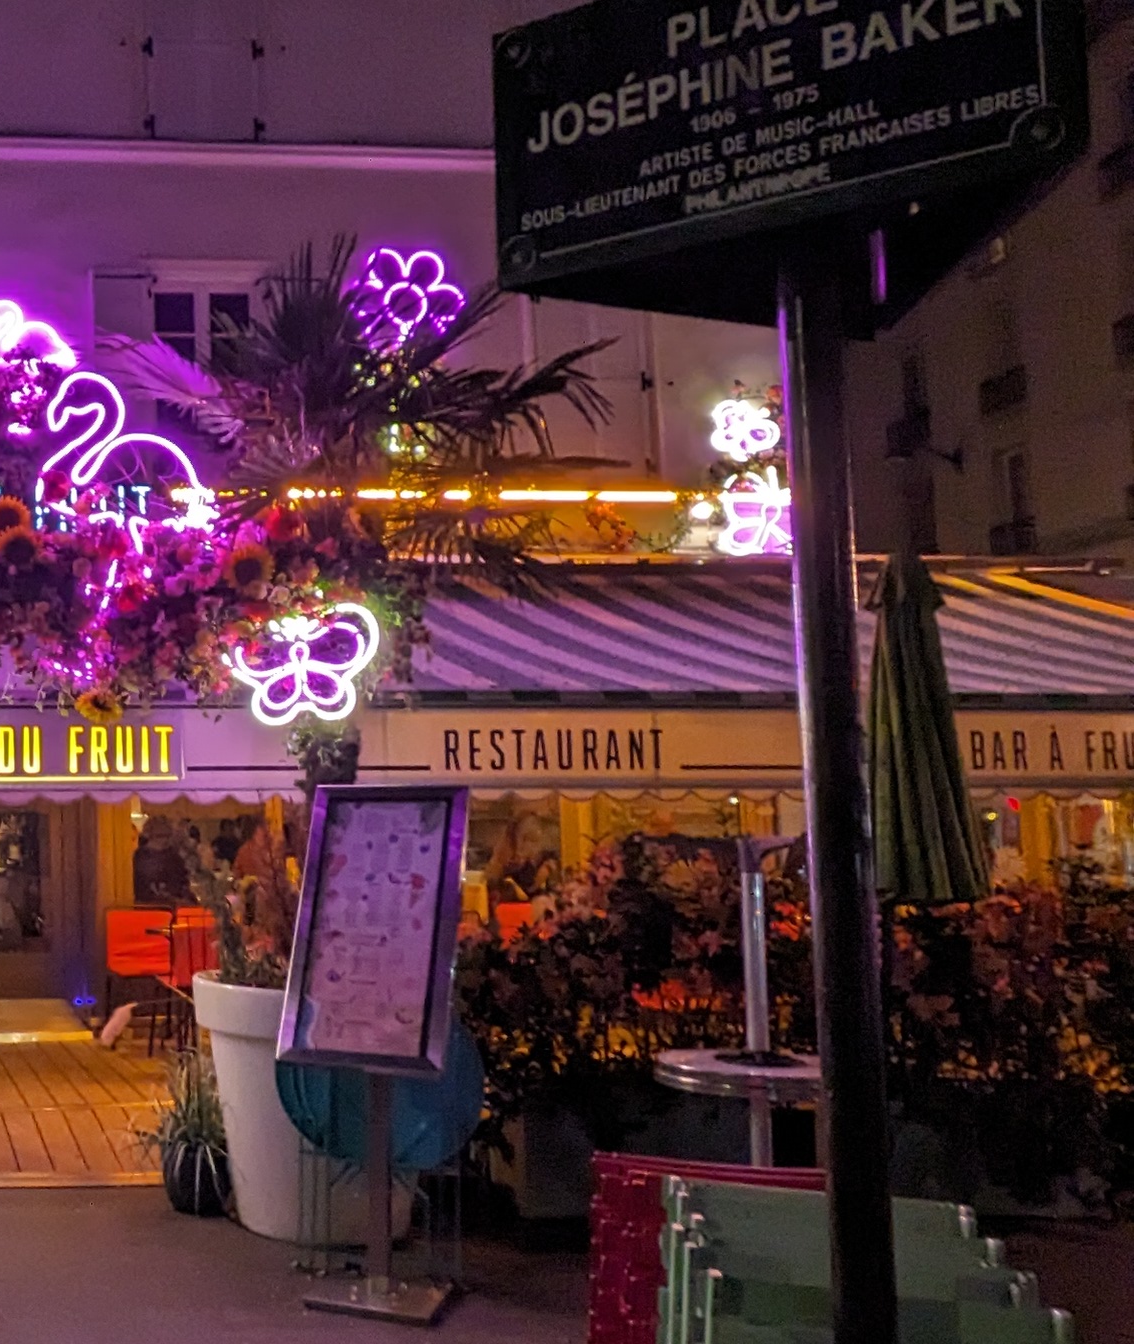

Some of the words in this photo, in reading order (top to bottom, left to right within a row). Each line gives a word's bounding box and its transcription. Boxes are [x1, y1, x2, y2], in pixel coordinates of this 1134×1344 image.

[526, 38, 795, 153] JOSÉPHINE
[772, 82, 820, 110] 1975
[520, 176, 680, 231] SOUS-LIEUTENANT
[689, 162, 727, 189] DES
[734, 142, 812, 178] FORCES
[960, 83, 1040, 122] LIBRES
[640, 142, 714, 177] ARTISTE
[720, 132, 748, 156] DE
[755, 98, 882, 146] MUSIC-HALL
[68, 725, 175, 775] FRUIT
[443, 728, 664, 771] RESTAURANT
[970, 730, 1028, 770] BAR
[1050, 724, 1064, 770] À
